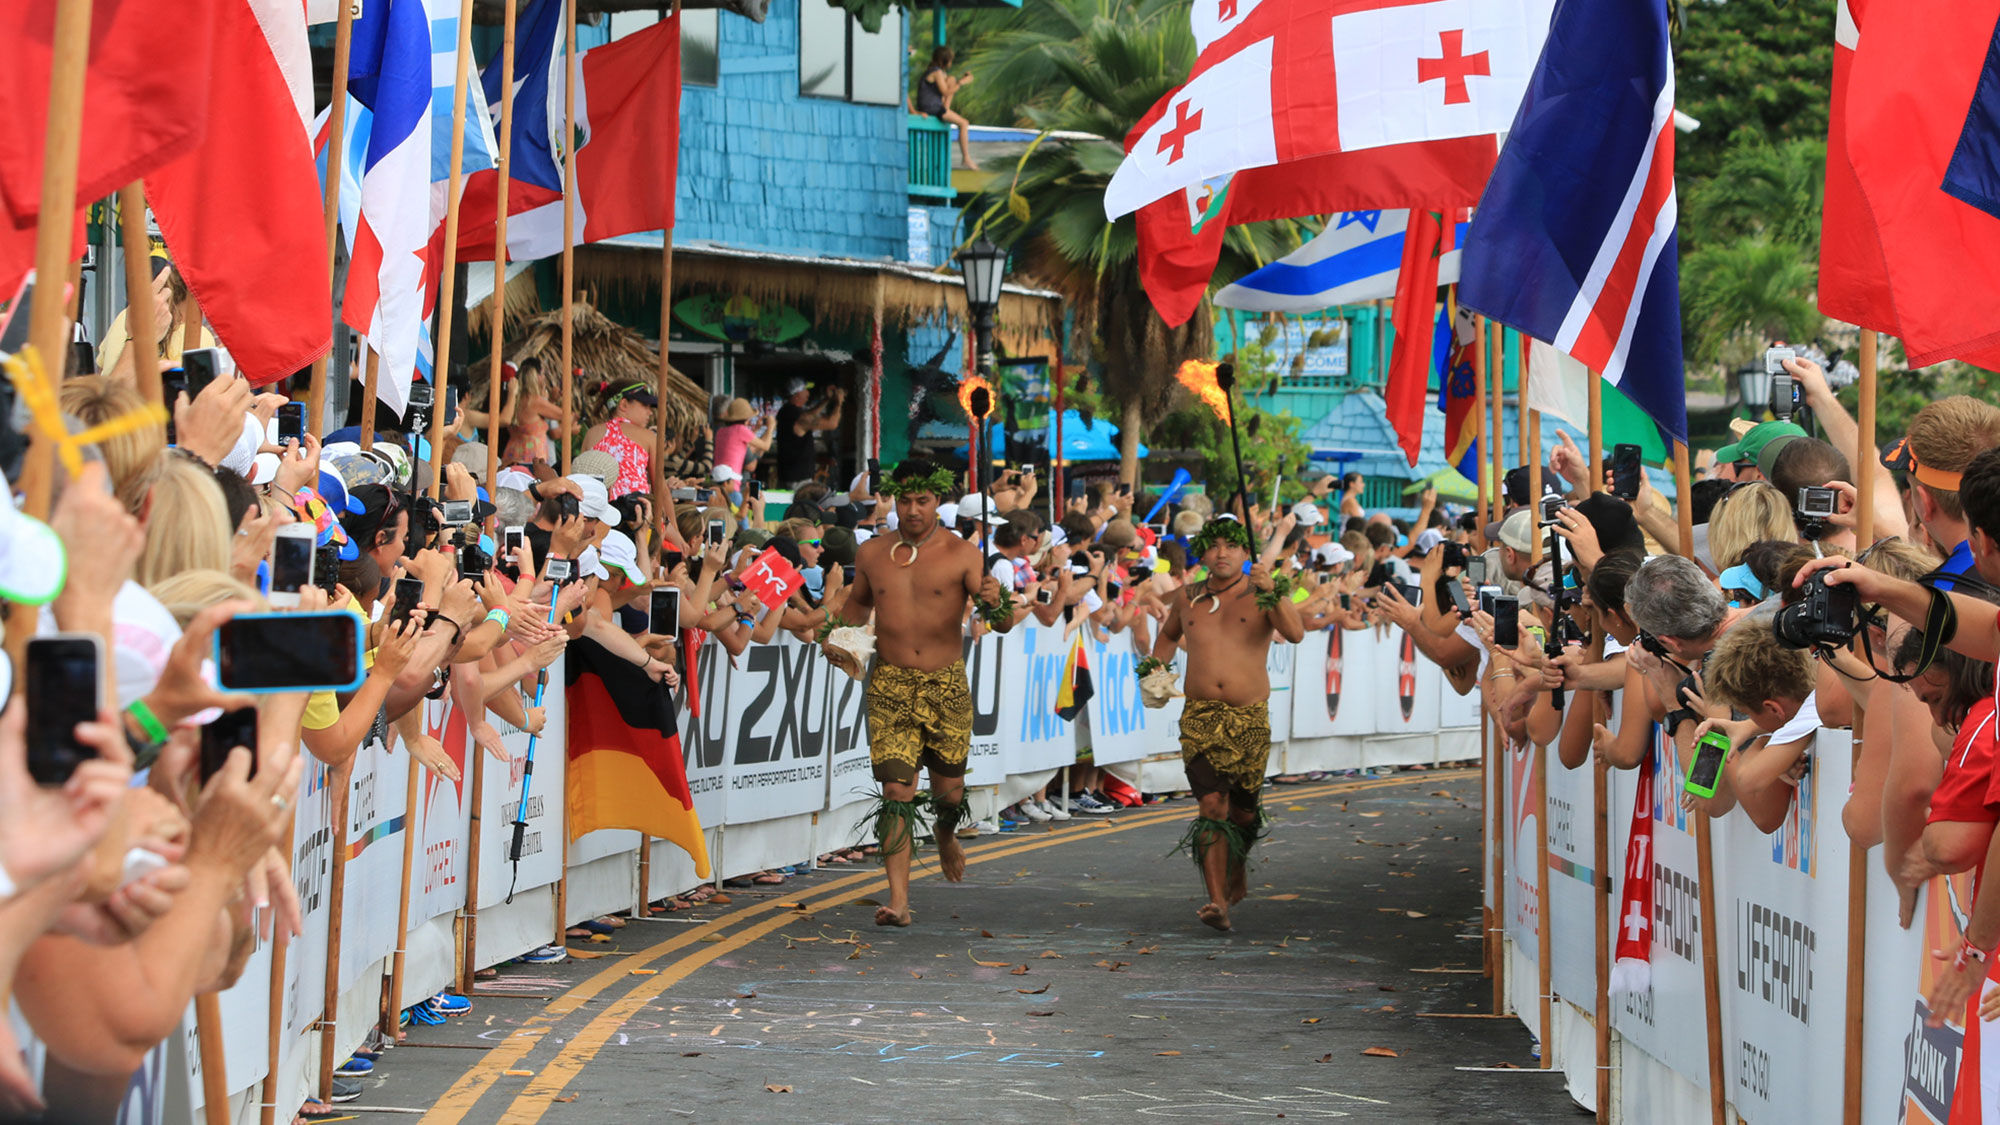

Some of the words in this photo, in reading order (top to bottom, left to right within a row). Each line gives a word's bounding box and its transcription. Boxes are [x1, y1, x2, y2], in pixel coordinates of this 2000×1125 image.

[757, 561, 788, 597] TYR
[734, 643, 834, 765] 2XU
[1910, 1012, 1948, 1105] BONK
